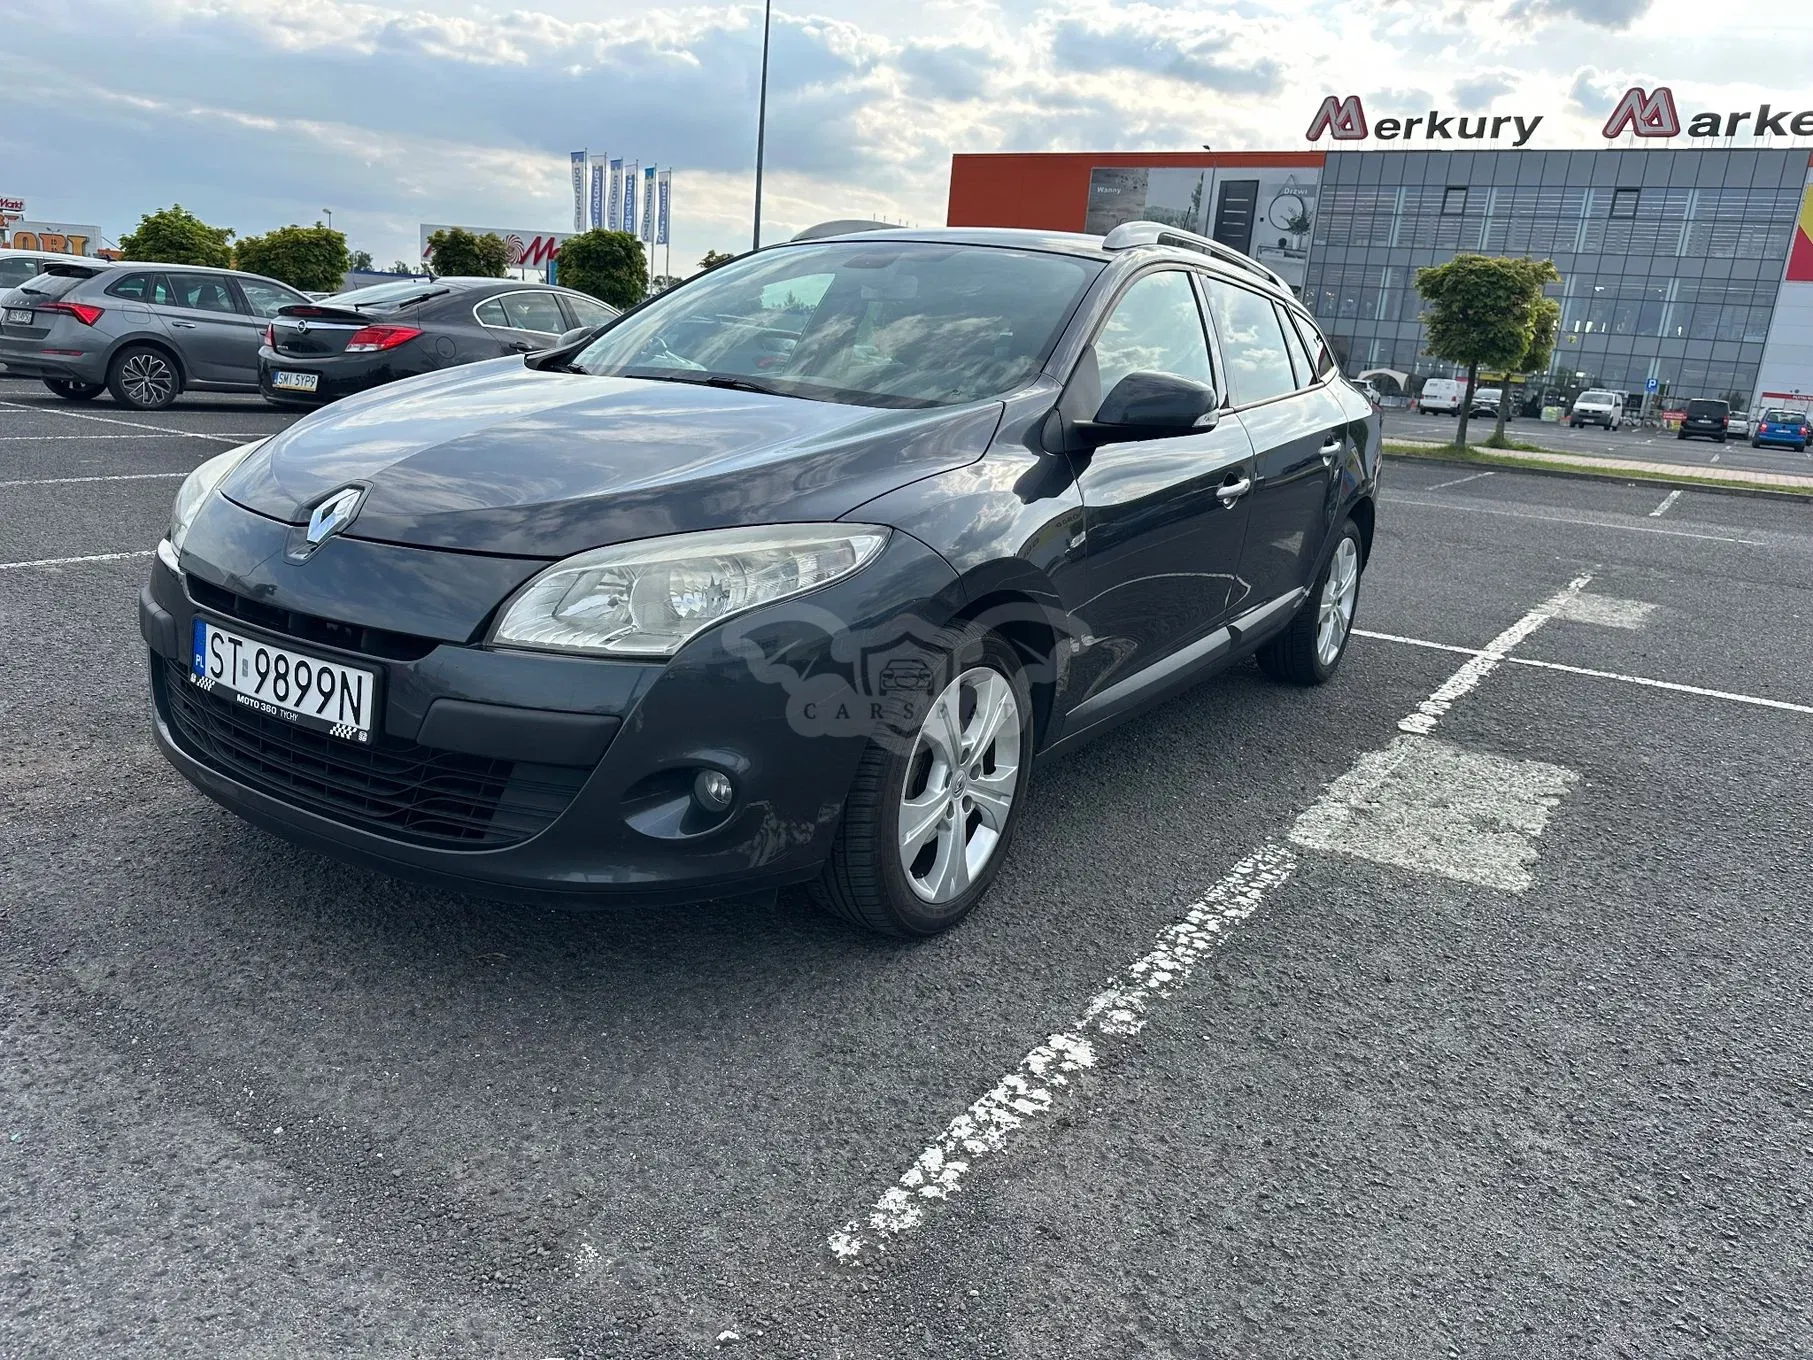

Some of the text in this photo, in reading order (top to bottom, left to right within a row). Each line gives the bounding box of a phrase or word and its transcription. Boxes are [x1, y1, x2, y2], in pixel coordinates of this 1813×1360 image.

[1305, 95, 1544, 147] Merkury
[1097, 186, 1122, 195] Wanny
[1284, 186, 1308, 195] Drzwi
[196, 654, 204, 669] PL
[210, 632, 363, 726] ST 9899N
[236, 693, 299, 722] MOTO 360 TYCHY
